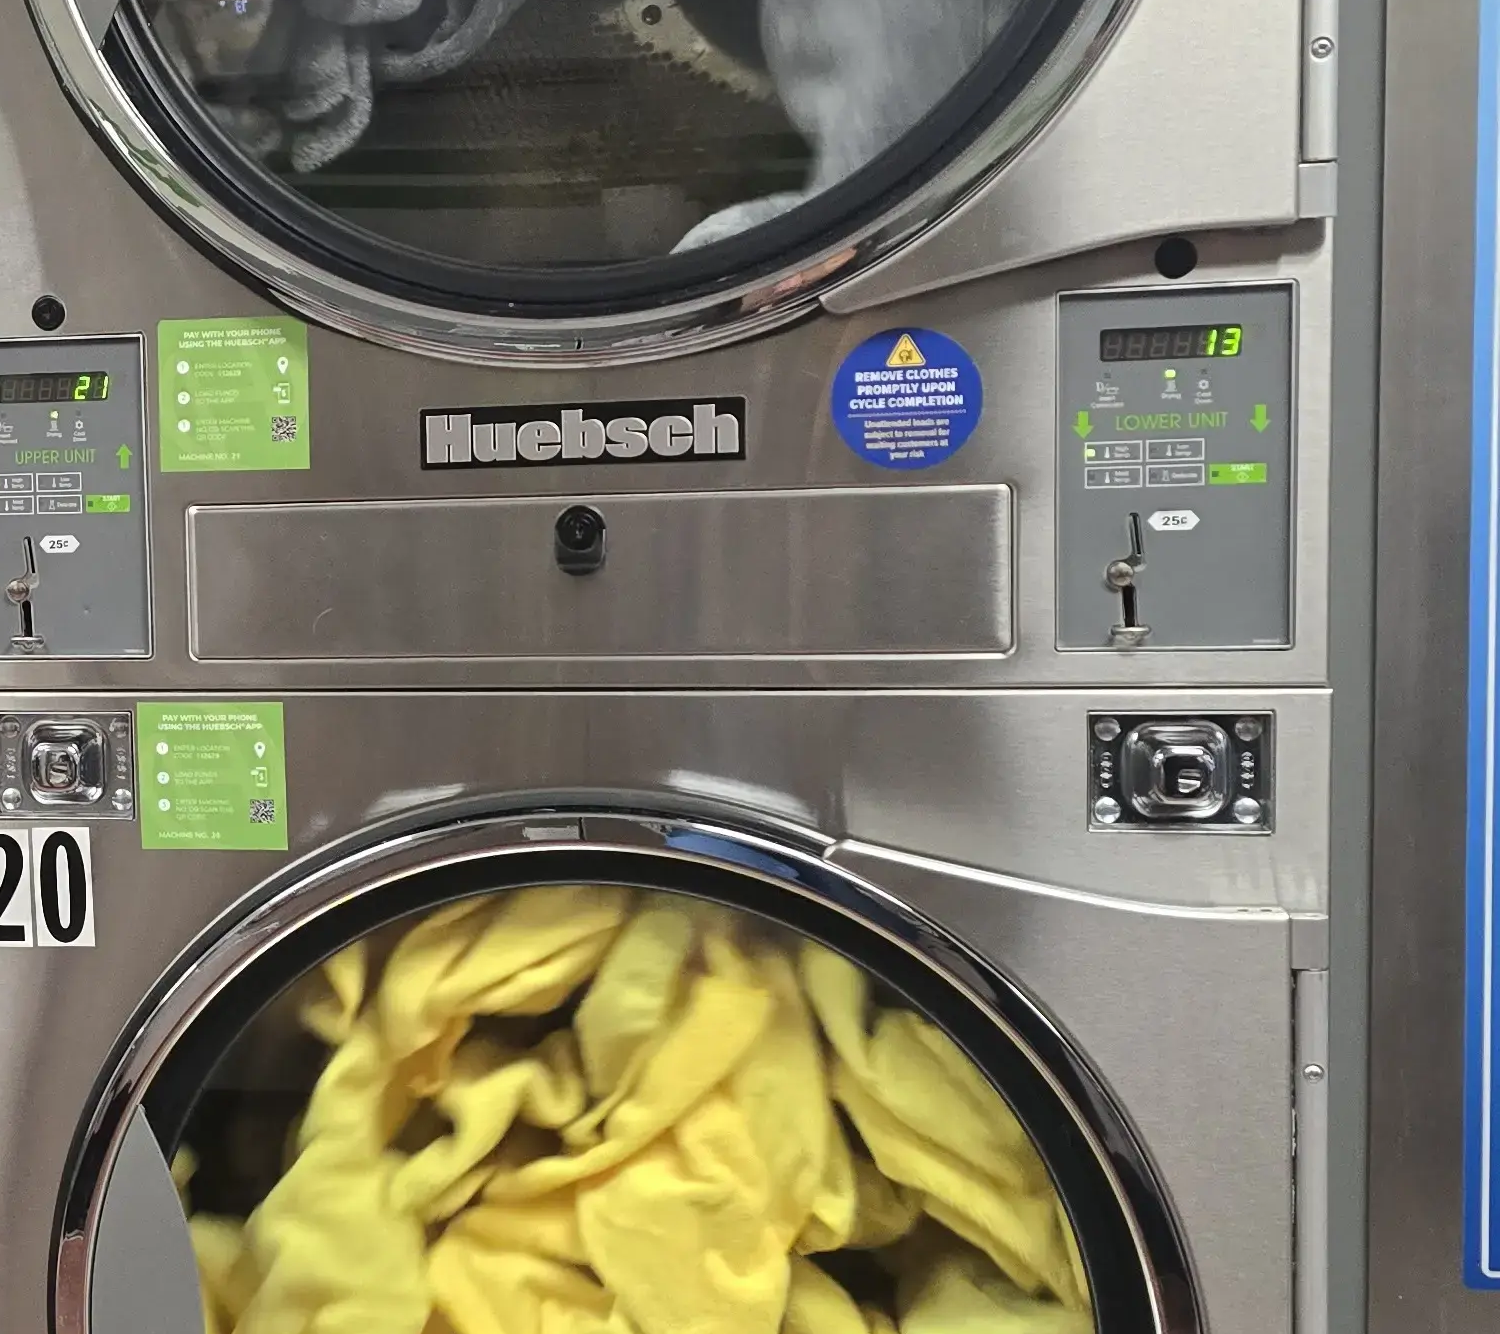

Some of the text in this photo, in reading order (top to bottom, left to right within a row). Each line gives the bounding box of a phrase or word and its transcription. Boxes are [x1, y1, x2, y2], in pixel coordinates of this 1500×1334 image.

[183, 328, 281, 339] PAY WITH YOUR PHONE
[178, 340, 204, 349] USING
[205, 339, 223, 347] THE
[268, 337, 287, 345] APP
[1206, 328, 1241, 356] 13
[855, 368, 959, 382] REMOVE CLOTHES
[74, 375, 109, 400] 21
[857, 382, 956, 396] PROMPTLY UPON
[849, 394, 964, 410] CYCLE COMPLETION
[1115, 411, 1229, 431] LOWER UNIT
[425, 404, 739, 464] Huebsch
[15, 448, 97, 465] UPPER UNIT
[162, 714, 257, 722] PAY WITH YOUR PHONE
[158, 723, 183, 731] USING
[184, 723, 201, 731] THE
